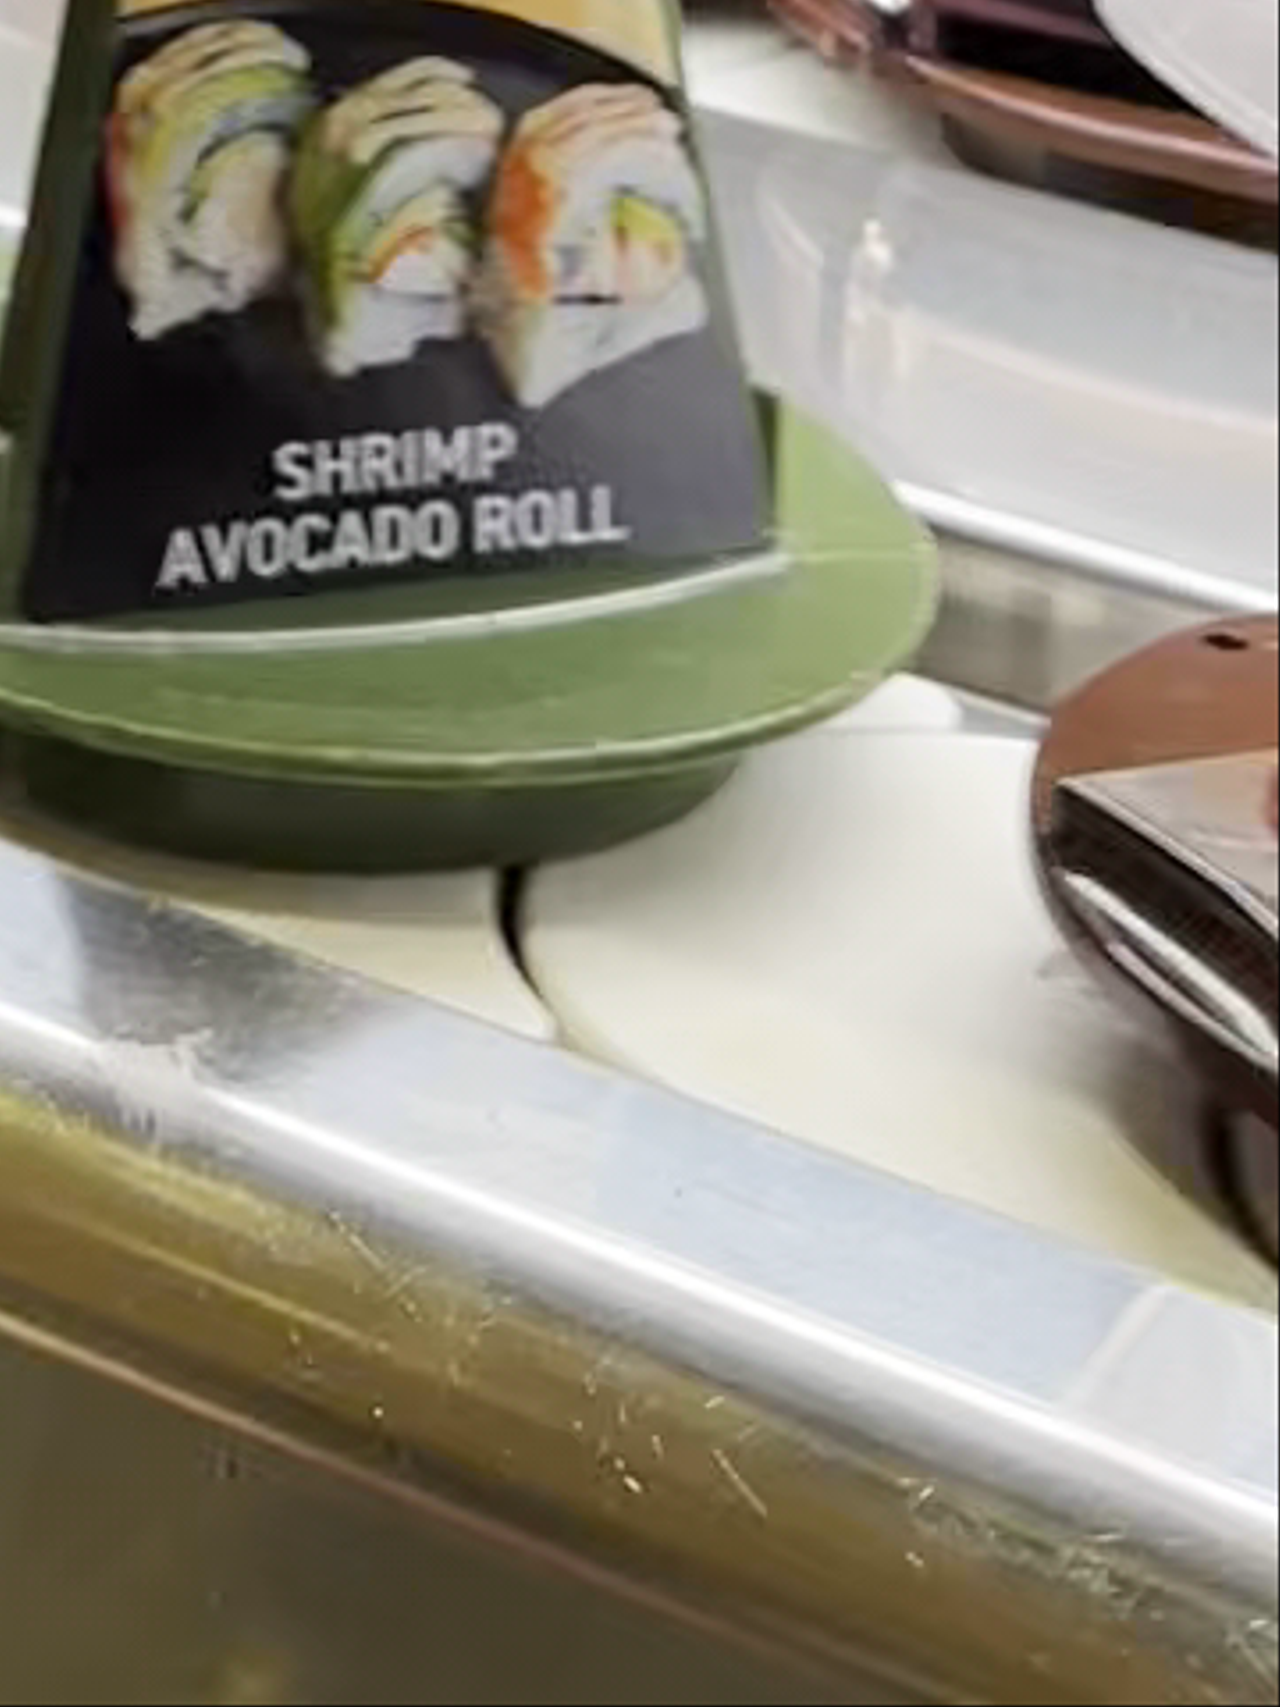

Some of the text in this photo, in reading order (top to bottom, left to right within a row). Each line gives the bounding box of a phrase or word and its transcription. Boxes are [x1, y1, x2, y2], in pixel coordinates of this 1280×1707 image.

[272, 421, 519, 501] SHRIMP
[155, 483, 631, 597] AVOCADO ROLL
